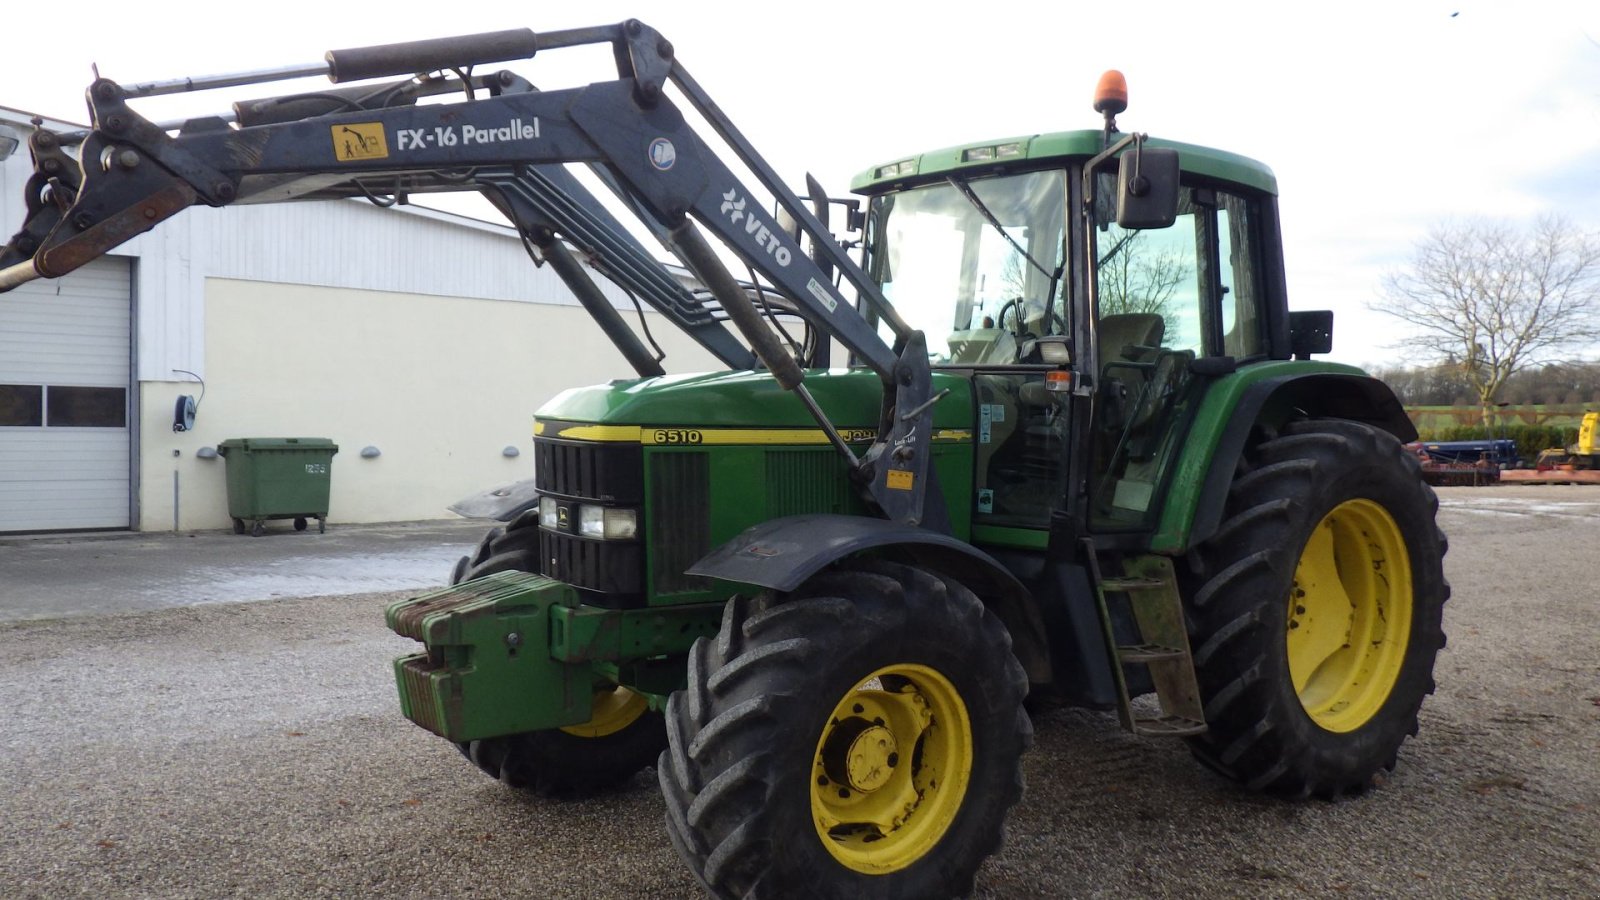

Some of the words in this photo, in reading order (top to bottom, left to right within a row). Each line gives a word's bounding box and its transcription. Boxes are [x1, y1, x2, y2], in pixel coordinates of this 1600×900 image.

[397, 126, 458, 150] FX-16
[462, 117, 540, 145] Parallel
[745, 211, 792, 267] VETO
[654, 430, 702, 444] 6510
